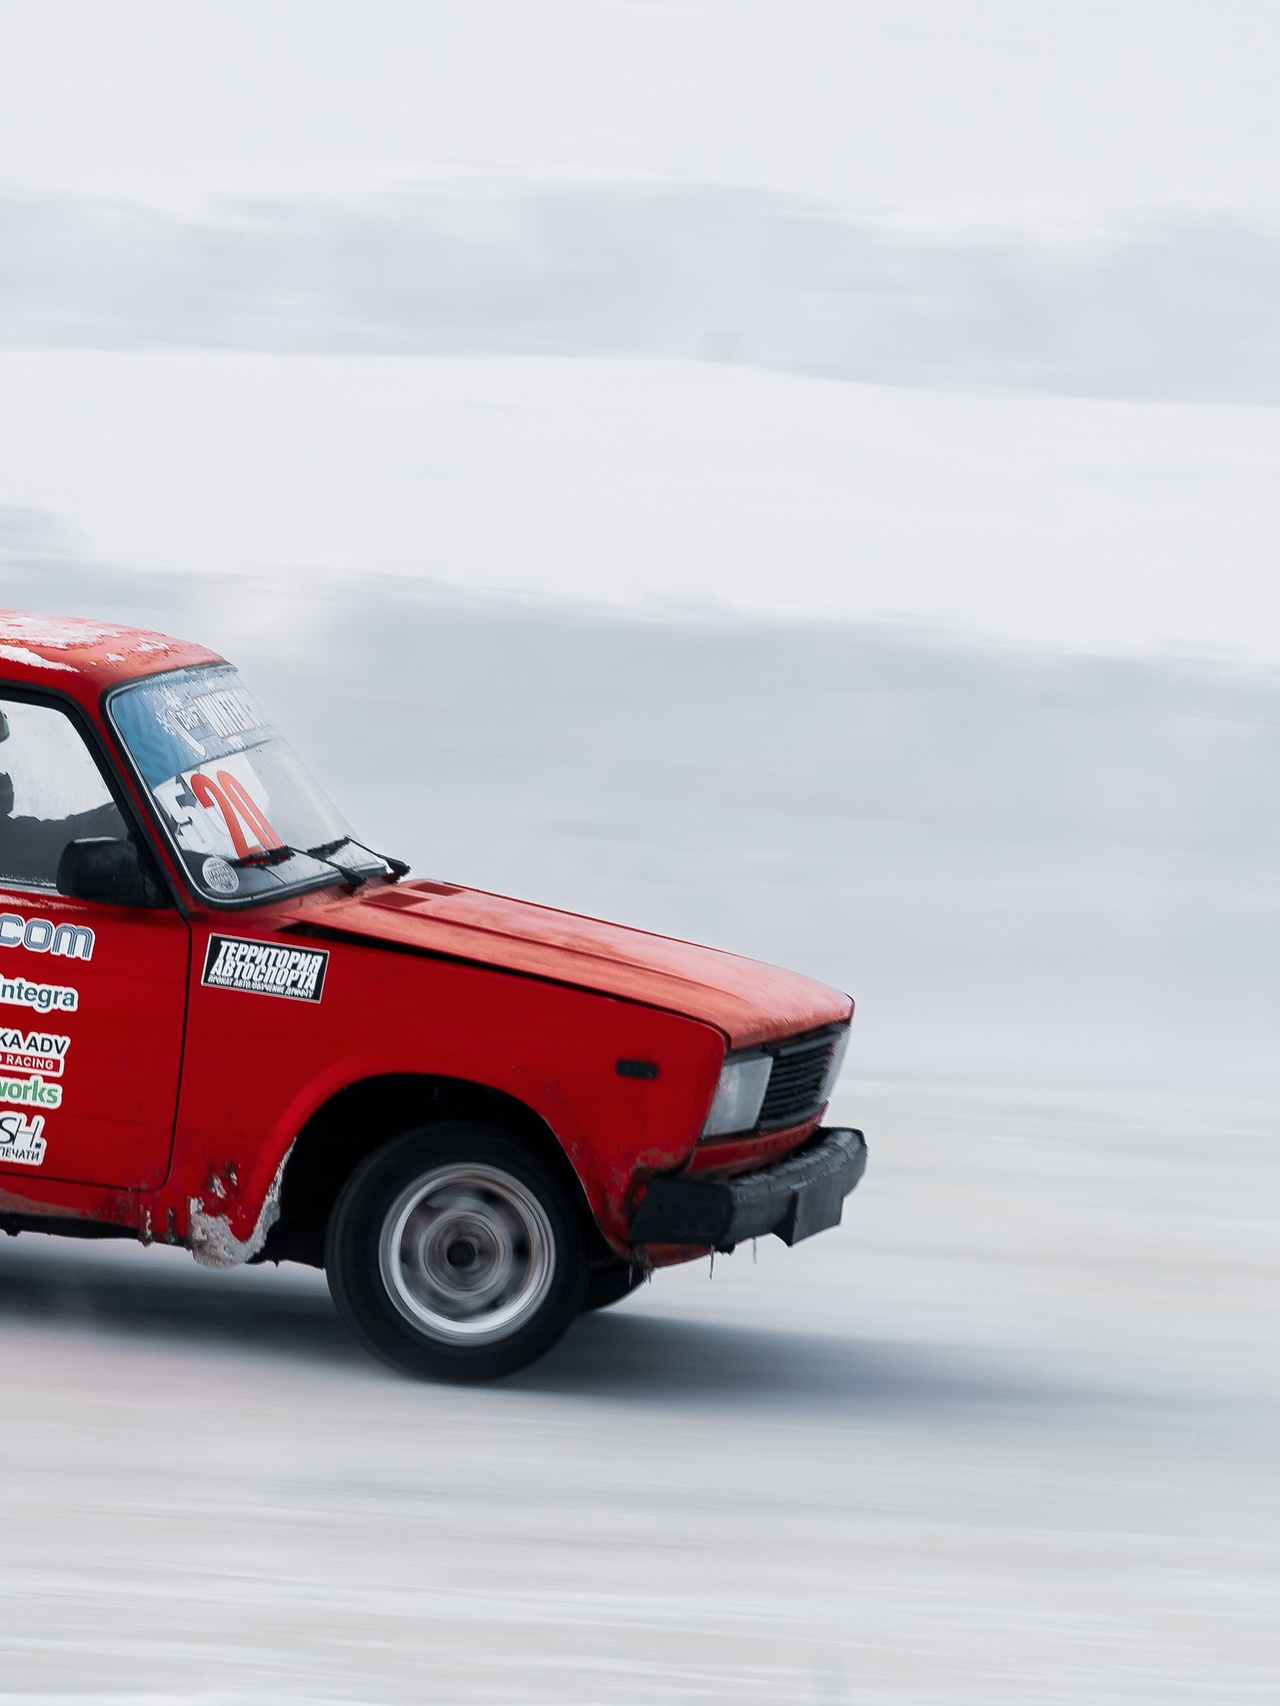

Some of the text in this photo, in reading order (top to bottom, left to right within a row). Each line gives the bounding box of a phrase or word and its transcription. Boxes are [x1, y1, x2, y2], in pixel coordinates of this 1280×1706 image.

[176, 706, 201, 731] DRIFT
[193, 690, 256, 738] WINTER
[210, 957, 318, 990] АВТОСПОРТА
[219, 941, 323, 974] ТЕРРИТОРИЯ
[26, 1036, 67, 1055] ADV
[6, 1054, 54, 1071] RACING
